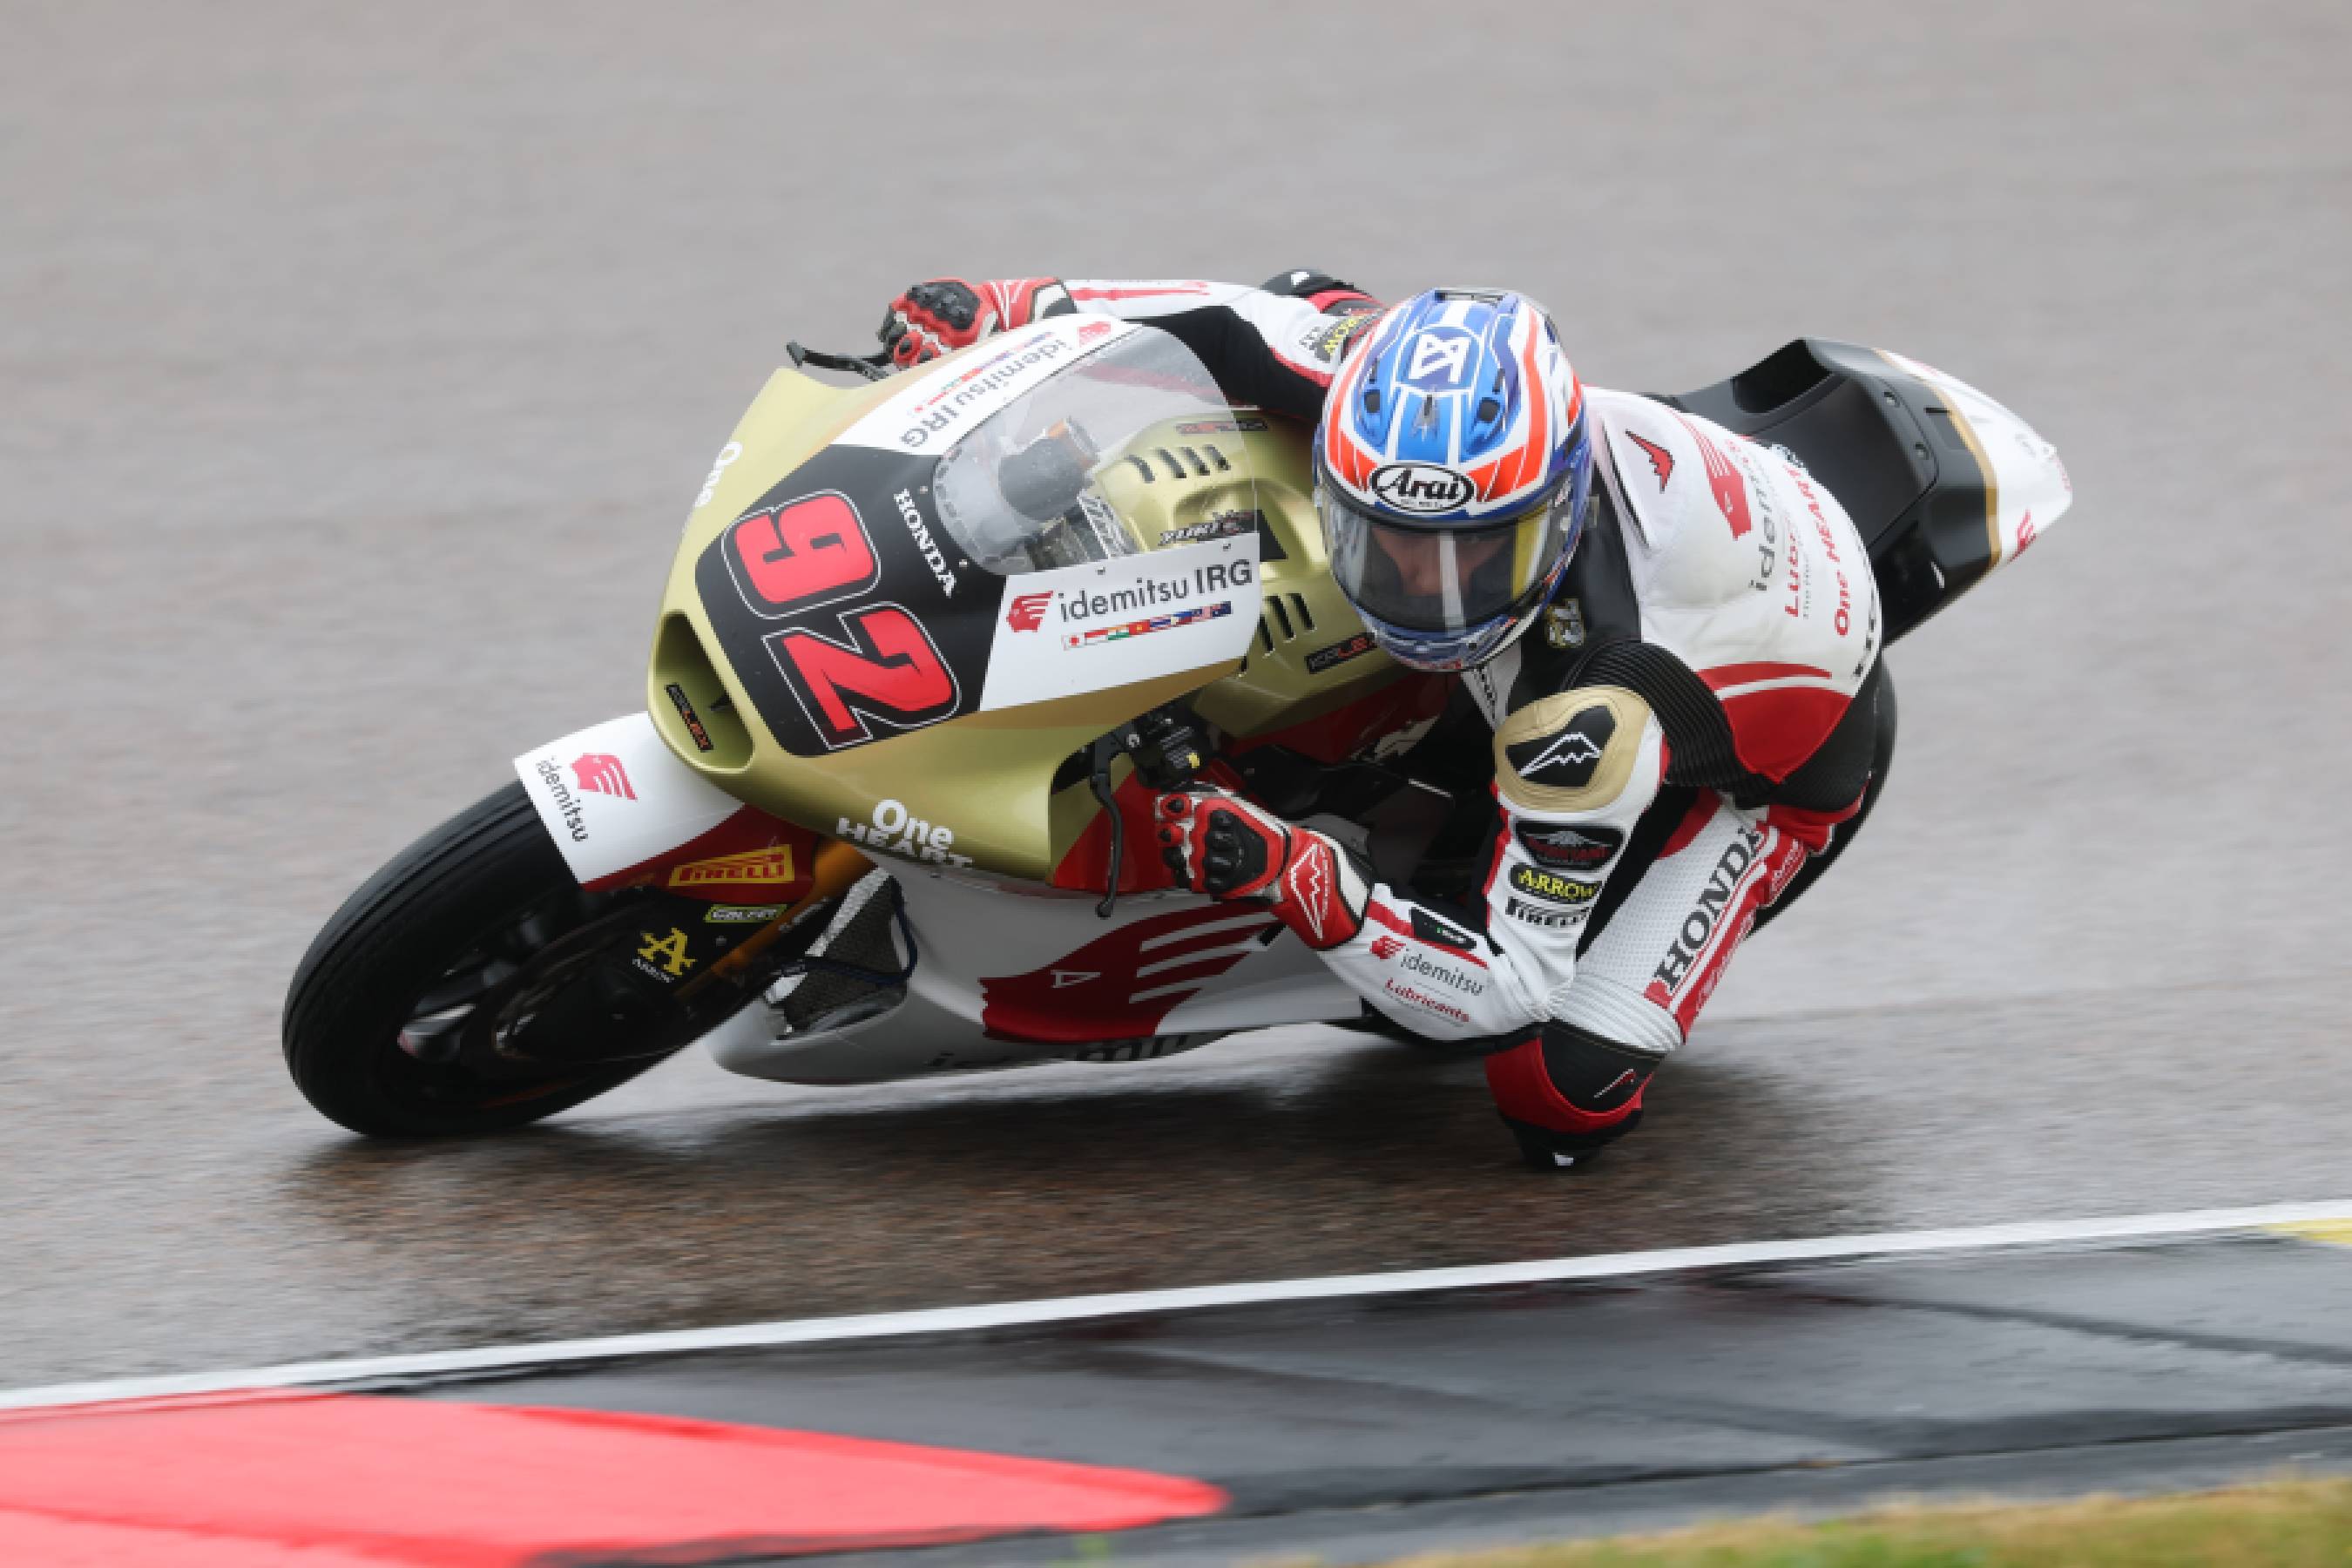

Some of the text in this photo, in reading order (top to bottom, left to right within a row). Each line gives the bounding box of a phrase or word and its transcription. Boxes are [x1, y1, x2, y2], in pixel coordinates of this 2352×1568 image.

[899, 338, 1072, 448] idemitsu IRG
[1377, 468, 1460, 500] Arai
[893, 487, 957, 599] HONDA
[721, 490, 961, 751] 92
[1058, 558, 1253, 622] idemitsu IRG
[1834, 568, 1851, 637] One
[536, 755, 589, 843] idemitsu
[872, 798, 955, 850] One
[678, 852, 786, 882] PIRELLI
[1385, 977, 1470, 1023] Lubricants
[1400, 947, 1484, 996] idemitsu
